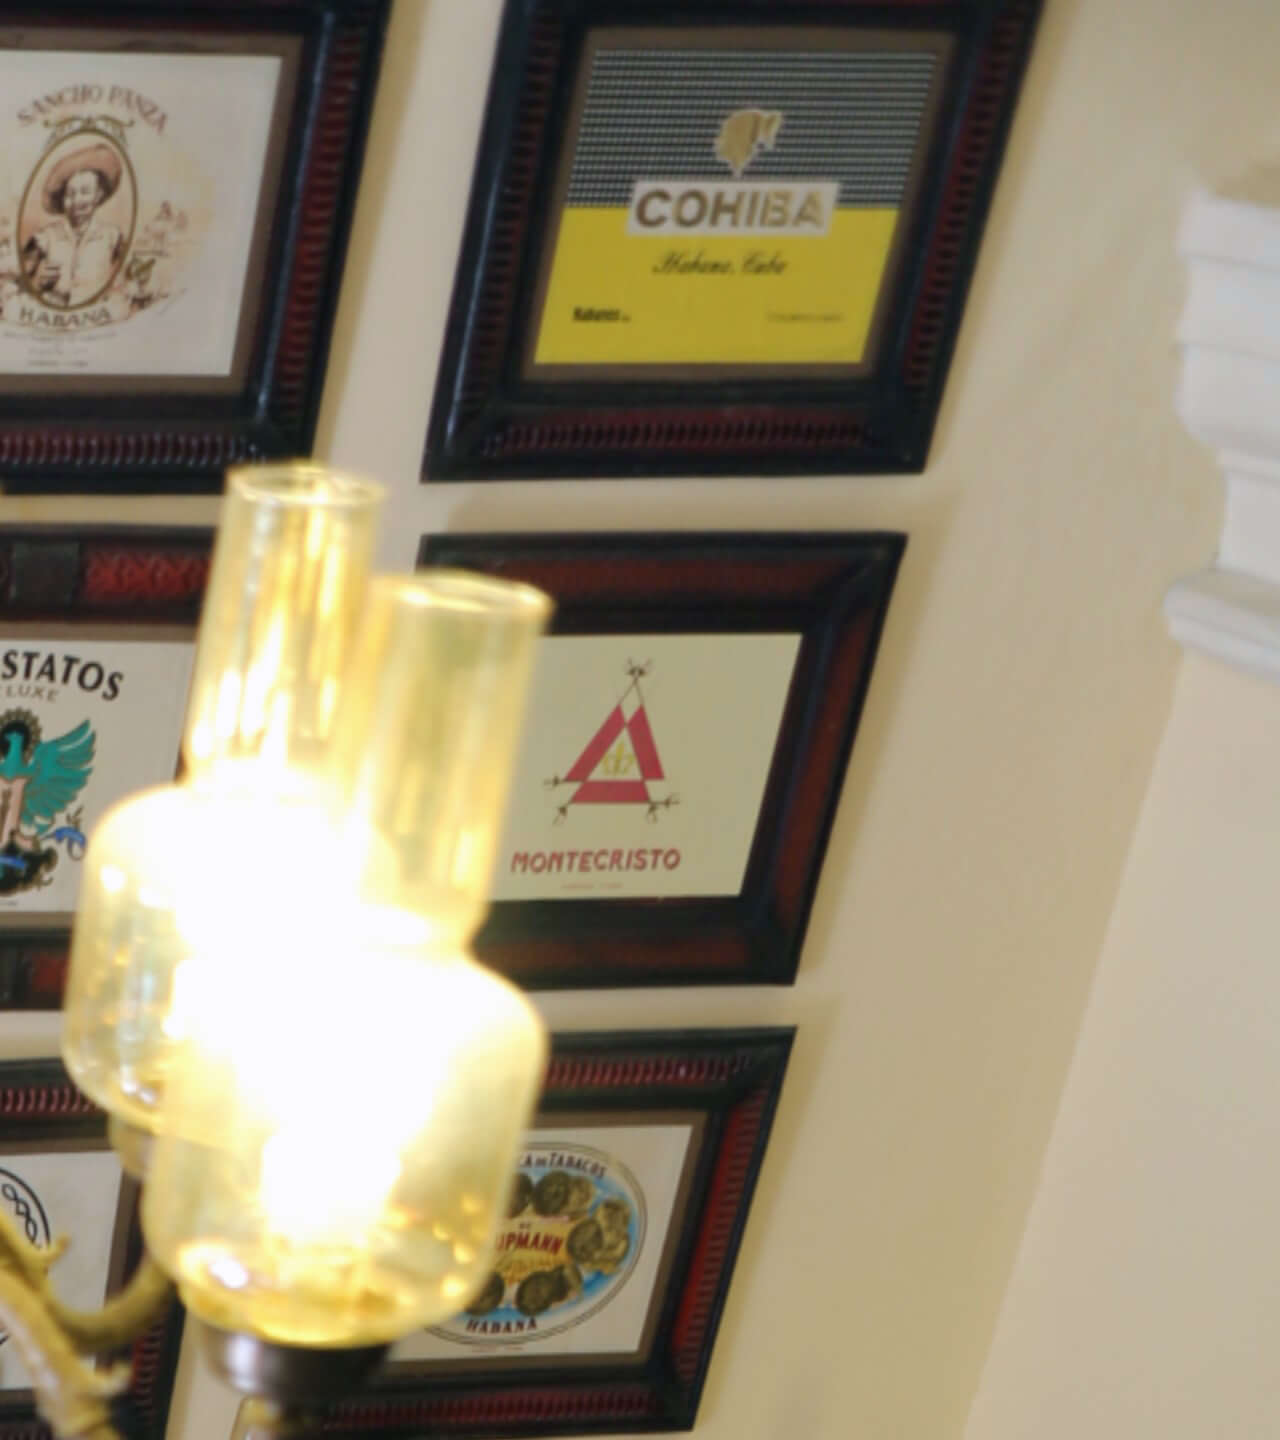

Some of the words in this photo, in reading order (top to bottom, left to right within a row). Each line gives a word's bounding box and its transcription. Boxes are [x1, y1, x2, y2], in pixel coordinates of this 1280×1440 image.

[17, 84, 104, 127] SANCHO
[109, 85, 169, 135] PANZA
[634, 188, 825, 229] COHIBA
[19, 306, 113, 327] HABANA
[0, 649, 125, 702] STATOS
[5, 685, 60, 702] LUXE
[509, 848, 682, 874] MONTECRISTO
[549, 1151, 608, 1179] TABACOS
[465, 1317, 538, 1335] HABANA
